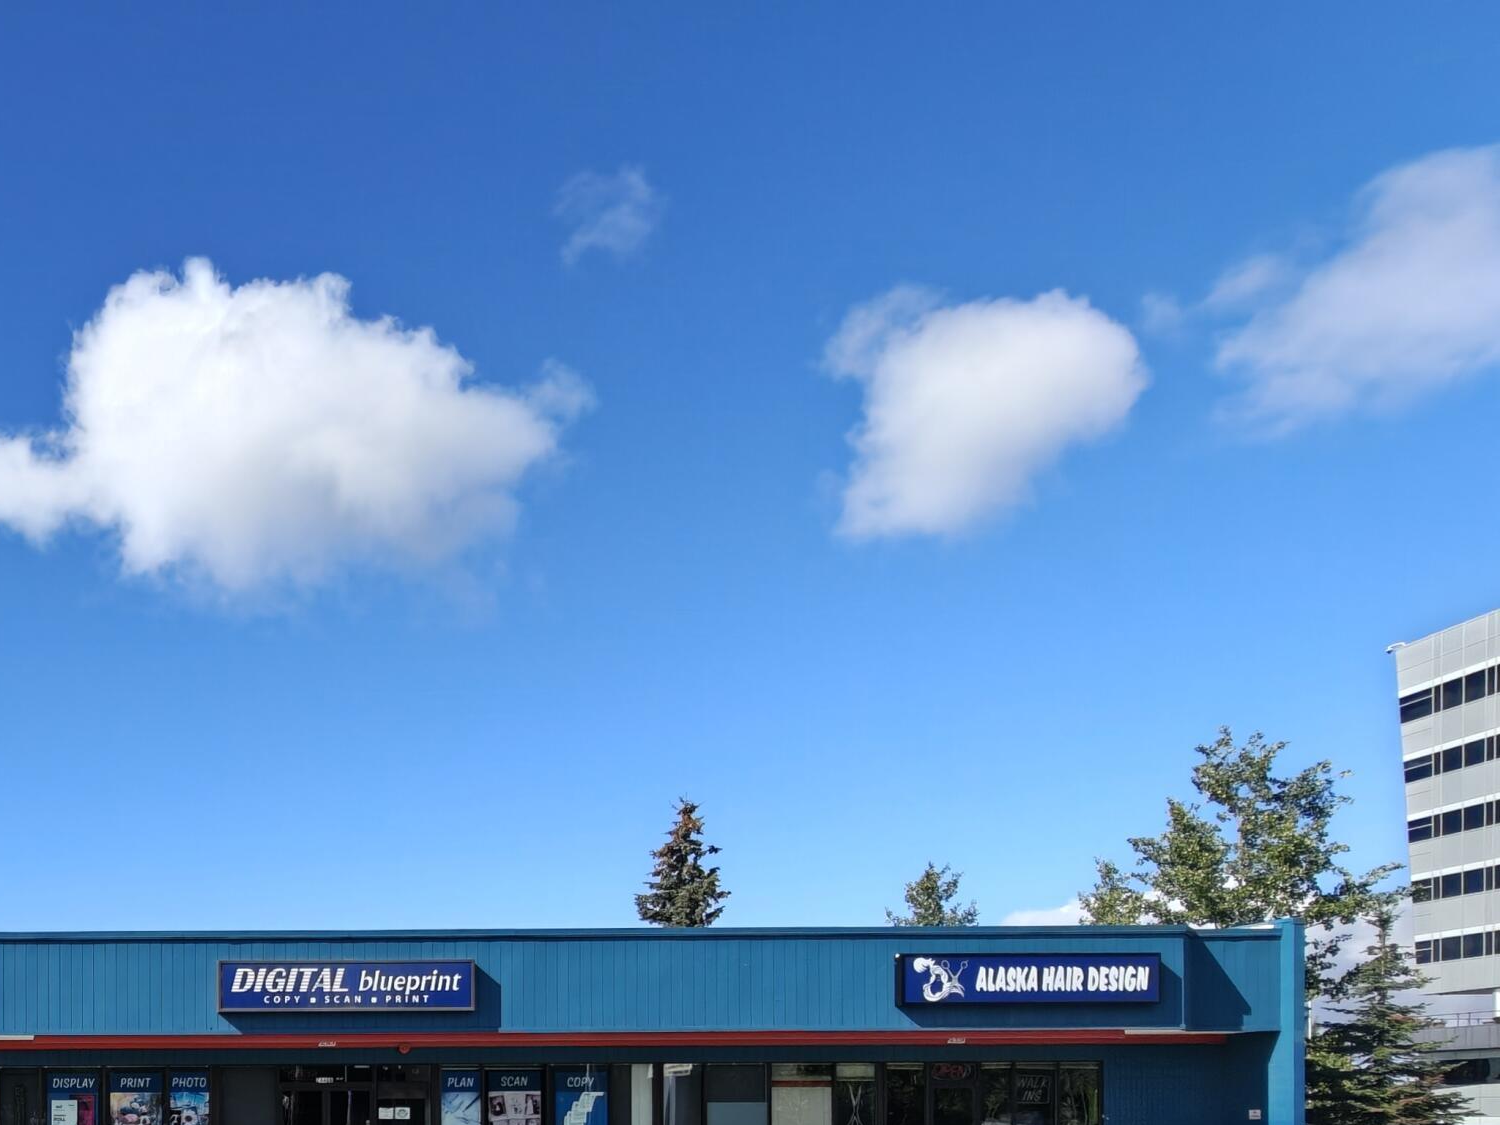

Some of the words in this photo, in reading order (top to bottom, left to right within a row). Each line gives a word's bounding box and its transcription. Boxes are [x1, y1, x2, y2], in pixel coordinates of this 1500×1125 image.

[231, 968, 350, 993] DIGITAL
[358, 969, 462, 995] blueprint
[975, 966, 1038, 992] ALASKA
[1042, 965, 1084, 993] HAIR
[1087, 966, 1150, 992] DESIGN
[263, 995, 300, 1004] COPY
[324, 995, 362, 1004] SCAN
[385, 994, 430, 1003] PRINT
[52, 1078, 95, 1089] DISPLAY
[120, 1077, 151, 1088] PRINT
[172, 1077, 207, 1088] PHOTO
[447, 1077, 474, 1087] PLAN
[500, 1076, 528, 1087] SCAN
[567, 1077, 594, 1087] COPY
